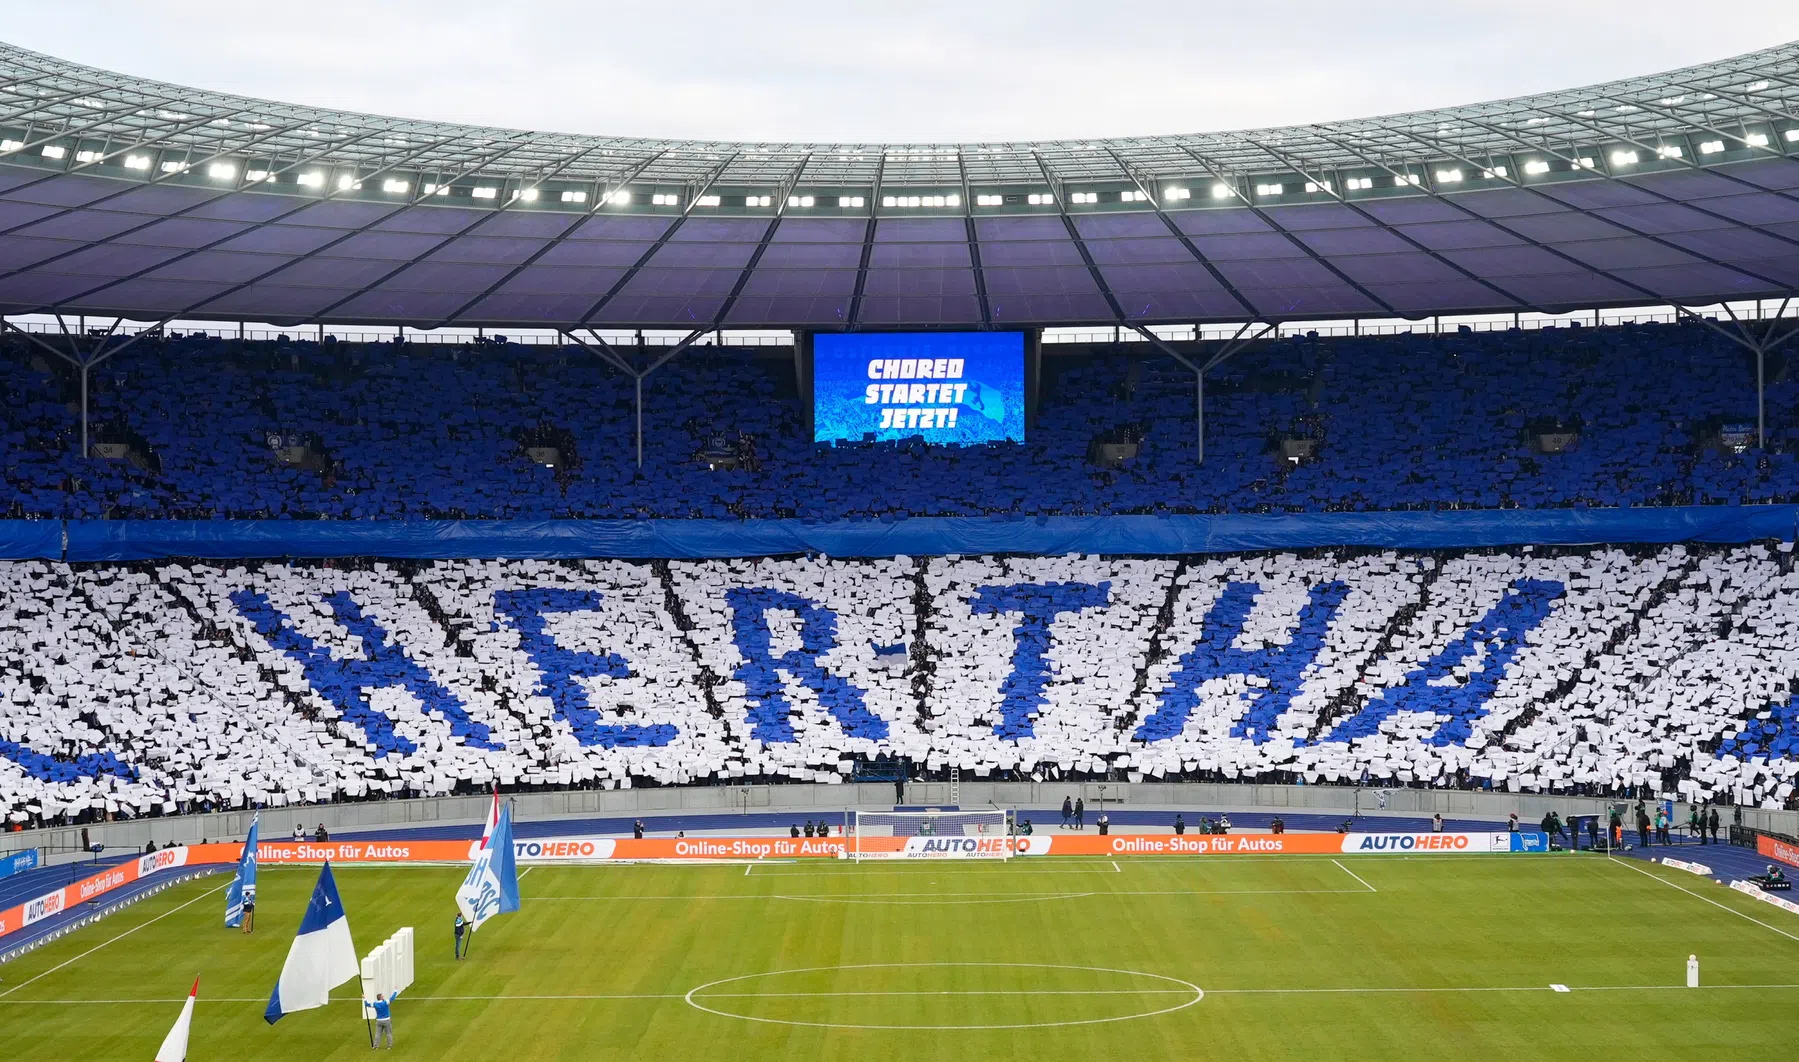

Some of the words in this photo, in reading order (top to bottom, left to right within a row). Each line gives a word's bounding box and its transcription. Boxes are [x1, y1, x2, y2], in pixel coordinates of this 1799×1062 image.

[867, 358, 965, 380] CHOREO
[864, 383, 969, 405] STARTET
[878, 407, 959, 429] JETZT!
[103, 446, 113, 454] 34
[229, 579, 1567, 759] HERTHA
[339, 845, 361, 858] für
[364, 844, 410, 858] Autos
[513, 842, 595, 857] TOHERO
[675, 841, 770, 856] Online-Shop
[774, 841, 797, 854] für
[801, 840, 846, 854] Autos
[1112, 837, 1208, 853] Online-Shop
[1211, 837, 1234, 850] für
[1238, 837, 1283, 850] Autos
[1360, 835, 1469, 850] AUTOHERO
[142, 850, 175, 873] AUTOHERO
[28, 893, 60, 921] AUTOHERO
